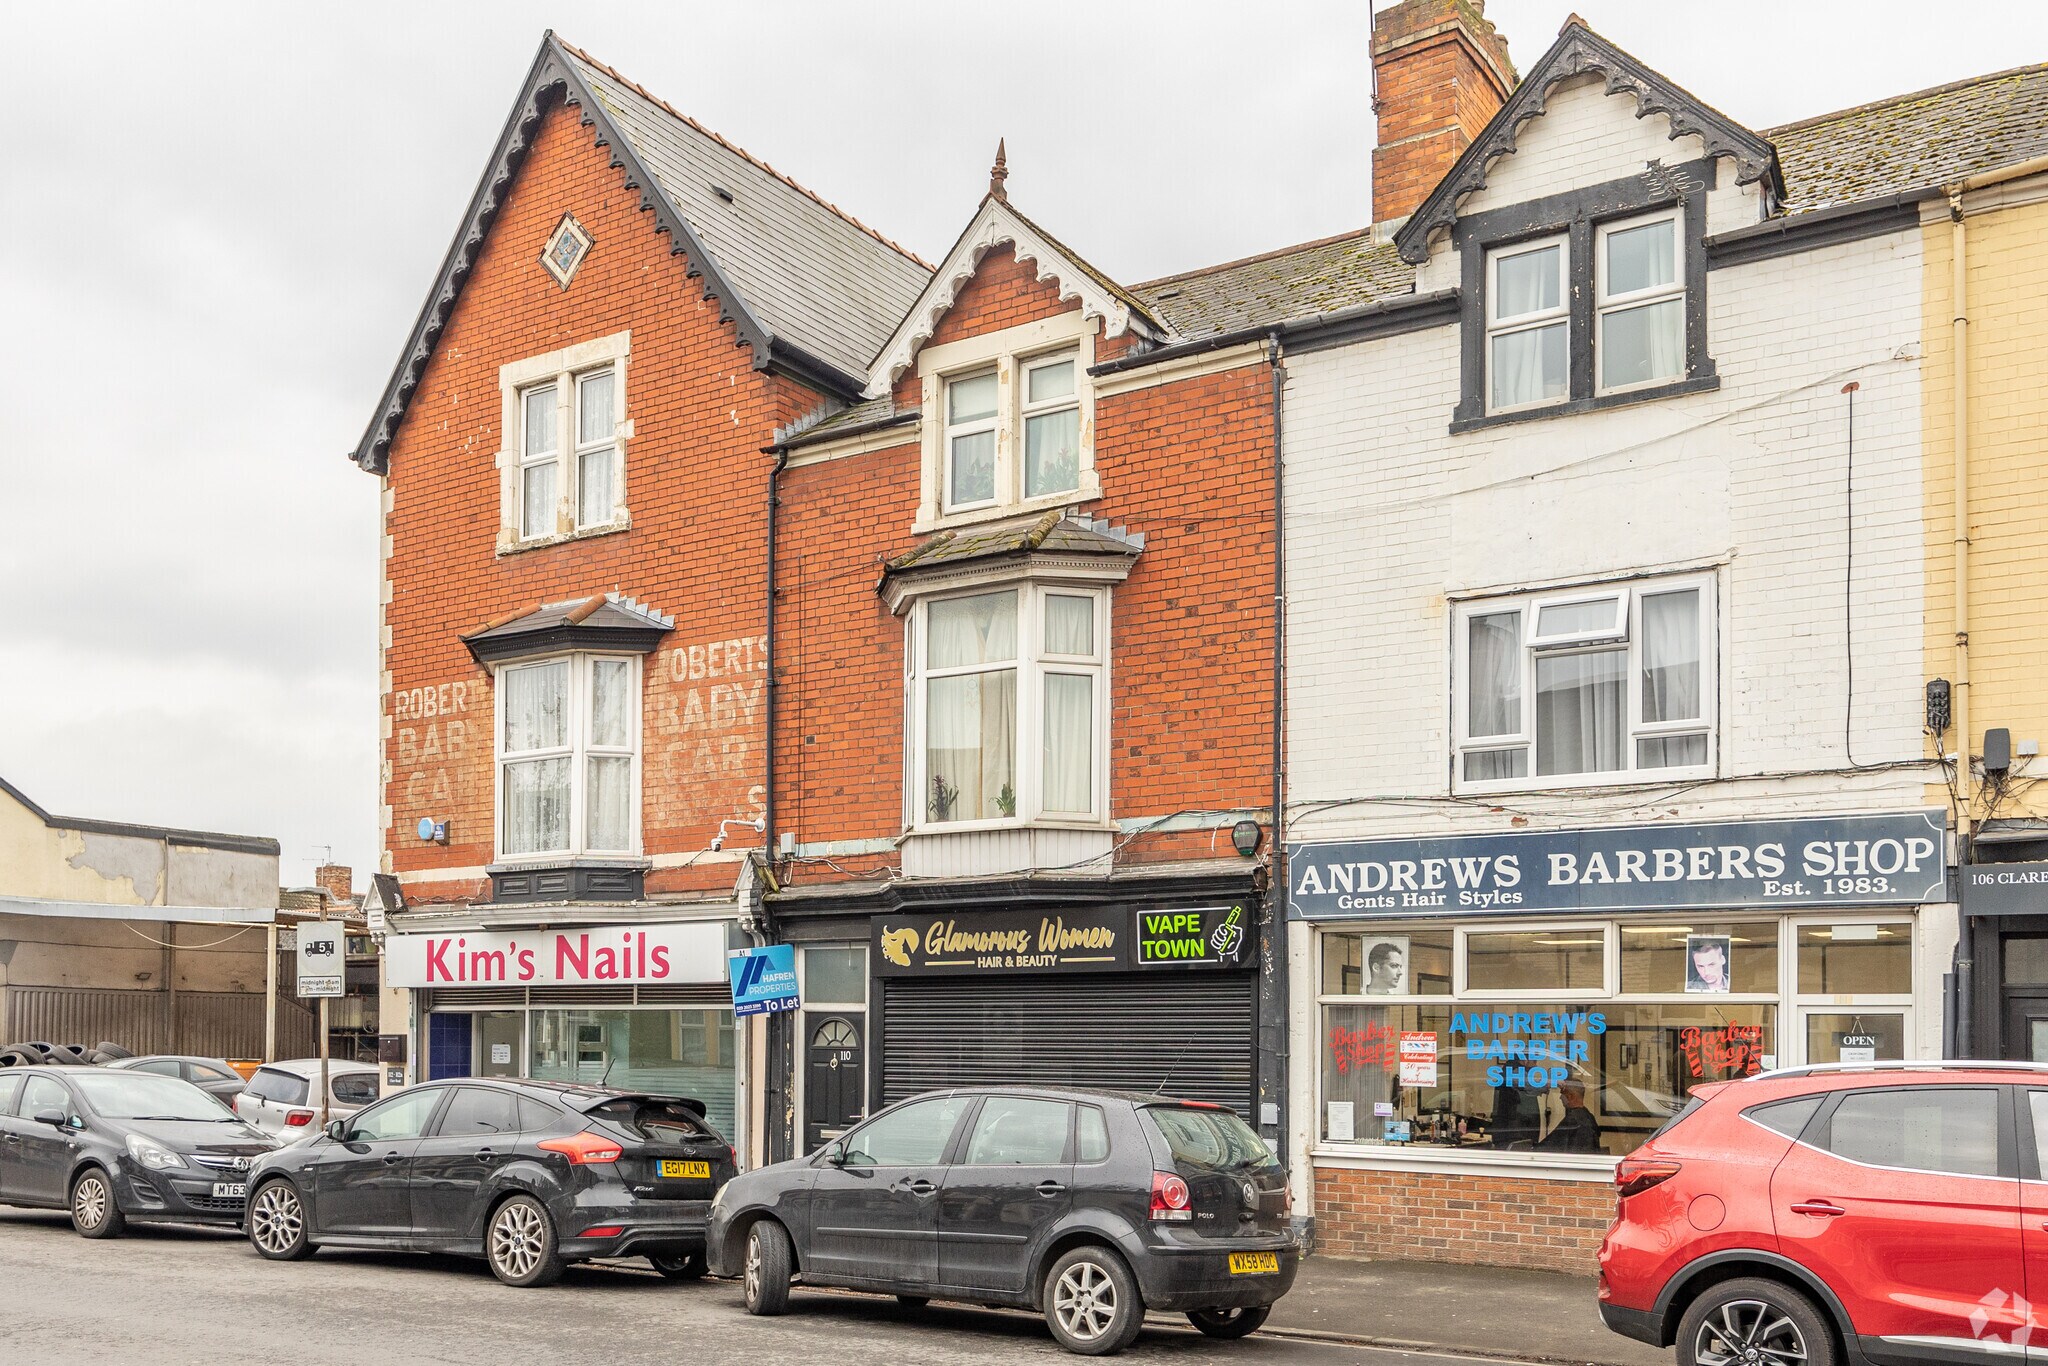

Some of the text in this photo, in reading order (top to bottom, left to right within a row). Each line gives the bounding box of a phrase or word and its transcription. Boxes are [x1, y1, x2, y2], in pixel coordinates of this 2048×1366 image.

[1295, 837, 1935, 896] ANDREWS BARBERS SHOP
[1763, 876, 1897, 896] Est. 1983.
[1972, 873, 1994, 885] 106
[1338, 889, 1523, 909] Gents Hair Styles
[1145, 914, 1200, 934] VAPE
[925, 916, 1115, 956] Glamorous Women
[319, 942, 333, 953] 5 T
[426, 931, 670, 982] Kim's Nails
[1142, 938, 1205, 958] TOWN
[977, 954, 1057, 968] HAIR & BEAUTY
[762, 971, 795, 983] HAFREN
[749, 981, 796, 996] PROPERTIES
[763, 999, 778, 1012] To
[780, 996, 799, 1010] Let
[1328, 1020, 1395, 1047] Barber
[1449, 1012, 1607, 1035] ANDREW'S
[1401, 1032, 1435, 1041] Andrew
[1680, 1019, 1763, 1050] Barber
[1843, 1035, 1875, 1046] OPEN
[840, 1050, 852, 1061] 110
[1346, 1041, 1385, 1064] Shop
[1467, 1039, 1589, 1062] BARBER
[1701, 1044, 1750, 1065] Shop
[1486, 1065, 1569, 1088] SHOP
[665, 1161, 707, 1175] EG17 LNX
[1233, 1253, 1275, 1270] WX58 HDC
